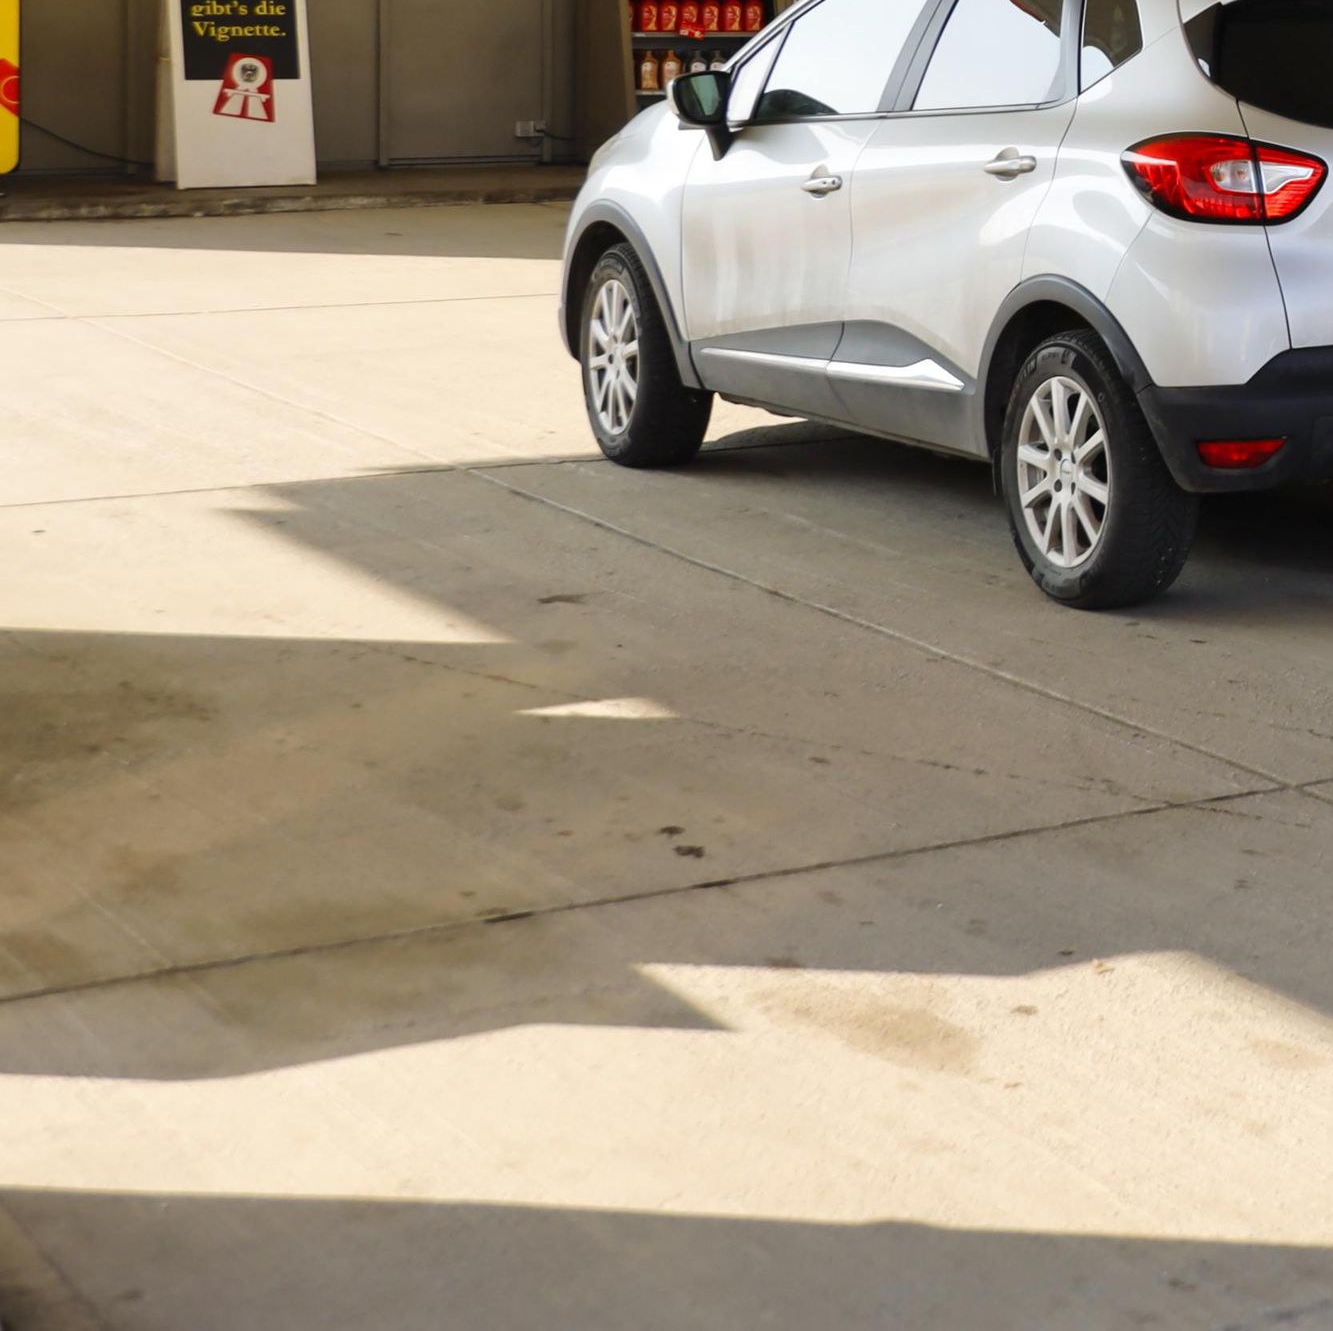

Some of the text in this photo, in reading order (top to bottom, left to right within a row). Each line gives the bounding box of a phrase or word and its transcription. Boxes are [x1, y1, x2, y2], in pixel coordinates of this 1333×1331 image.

[191, 0, 286, 17] gibt's die
[192, 21, 286, 42] Vignette.
